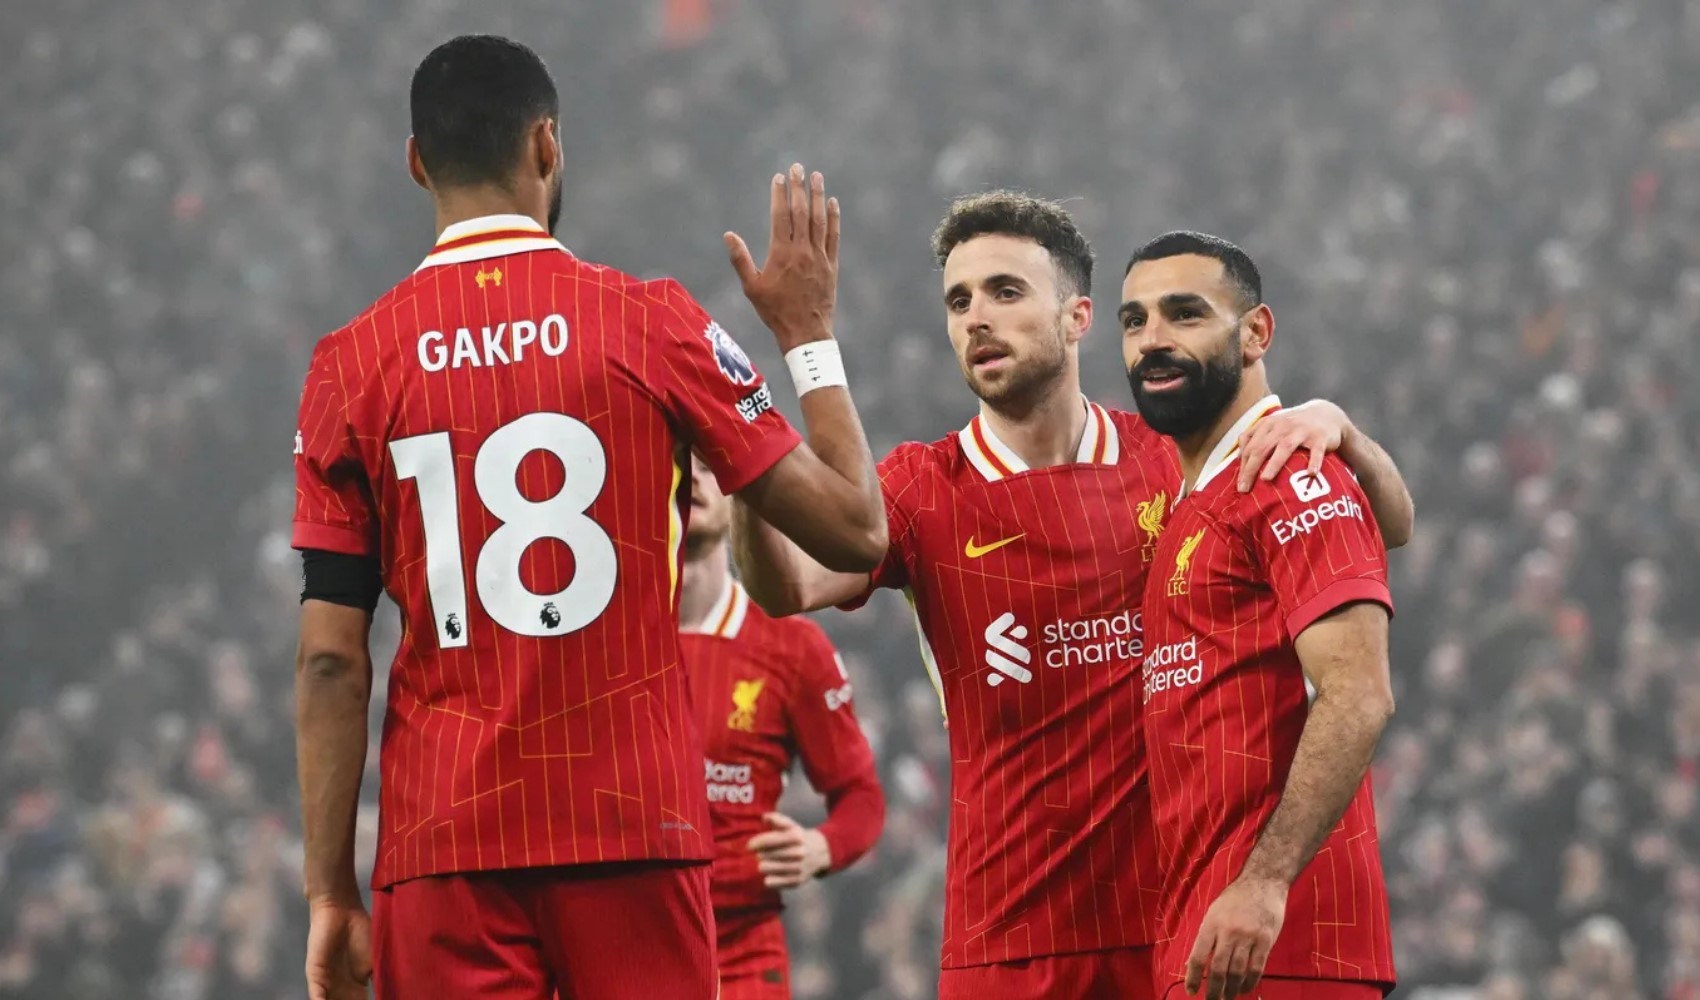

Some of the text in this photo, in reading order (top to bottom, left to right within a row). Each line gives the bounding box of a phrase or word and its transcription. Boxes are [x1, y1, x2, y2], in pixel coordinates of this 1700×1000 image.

[417, 313, 569, 373] GAKPO
[735, 397, 753, 415] No
[389, 412, 617, 648] 18
